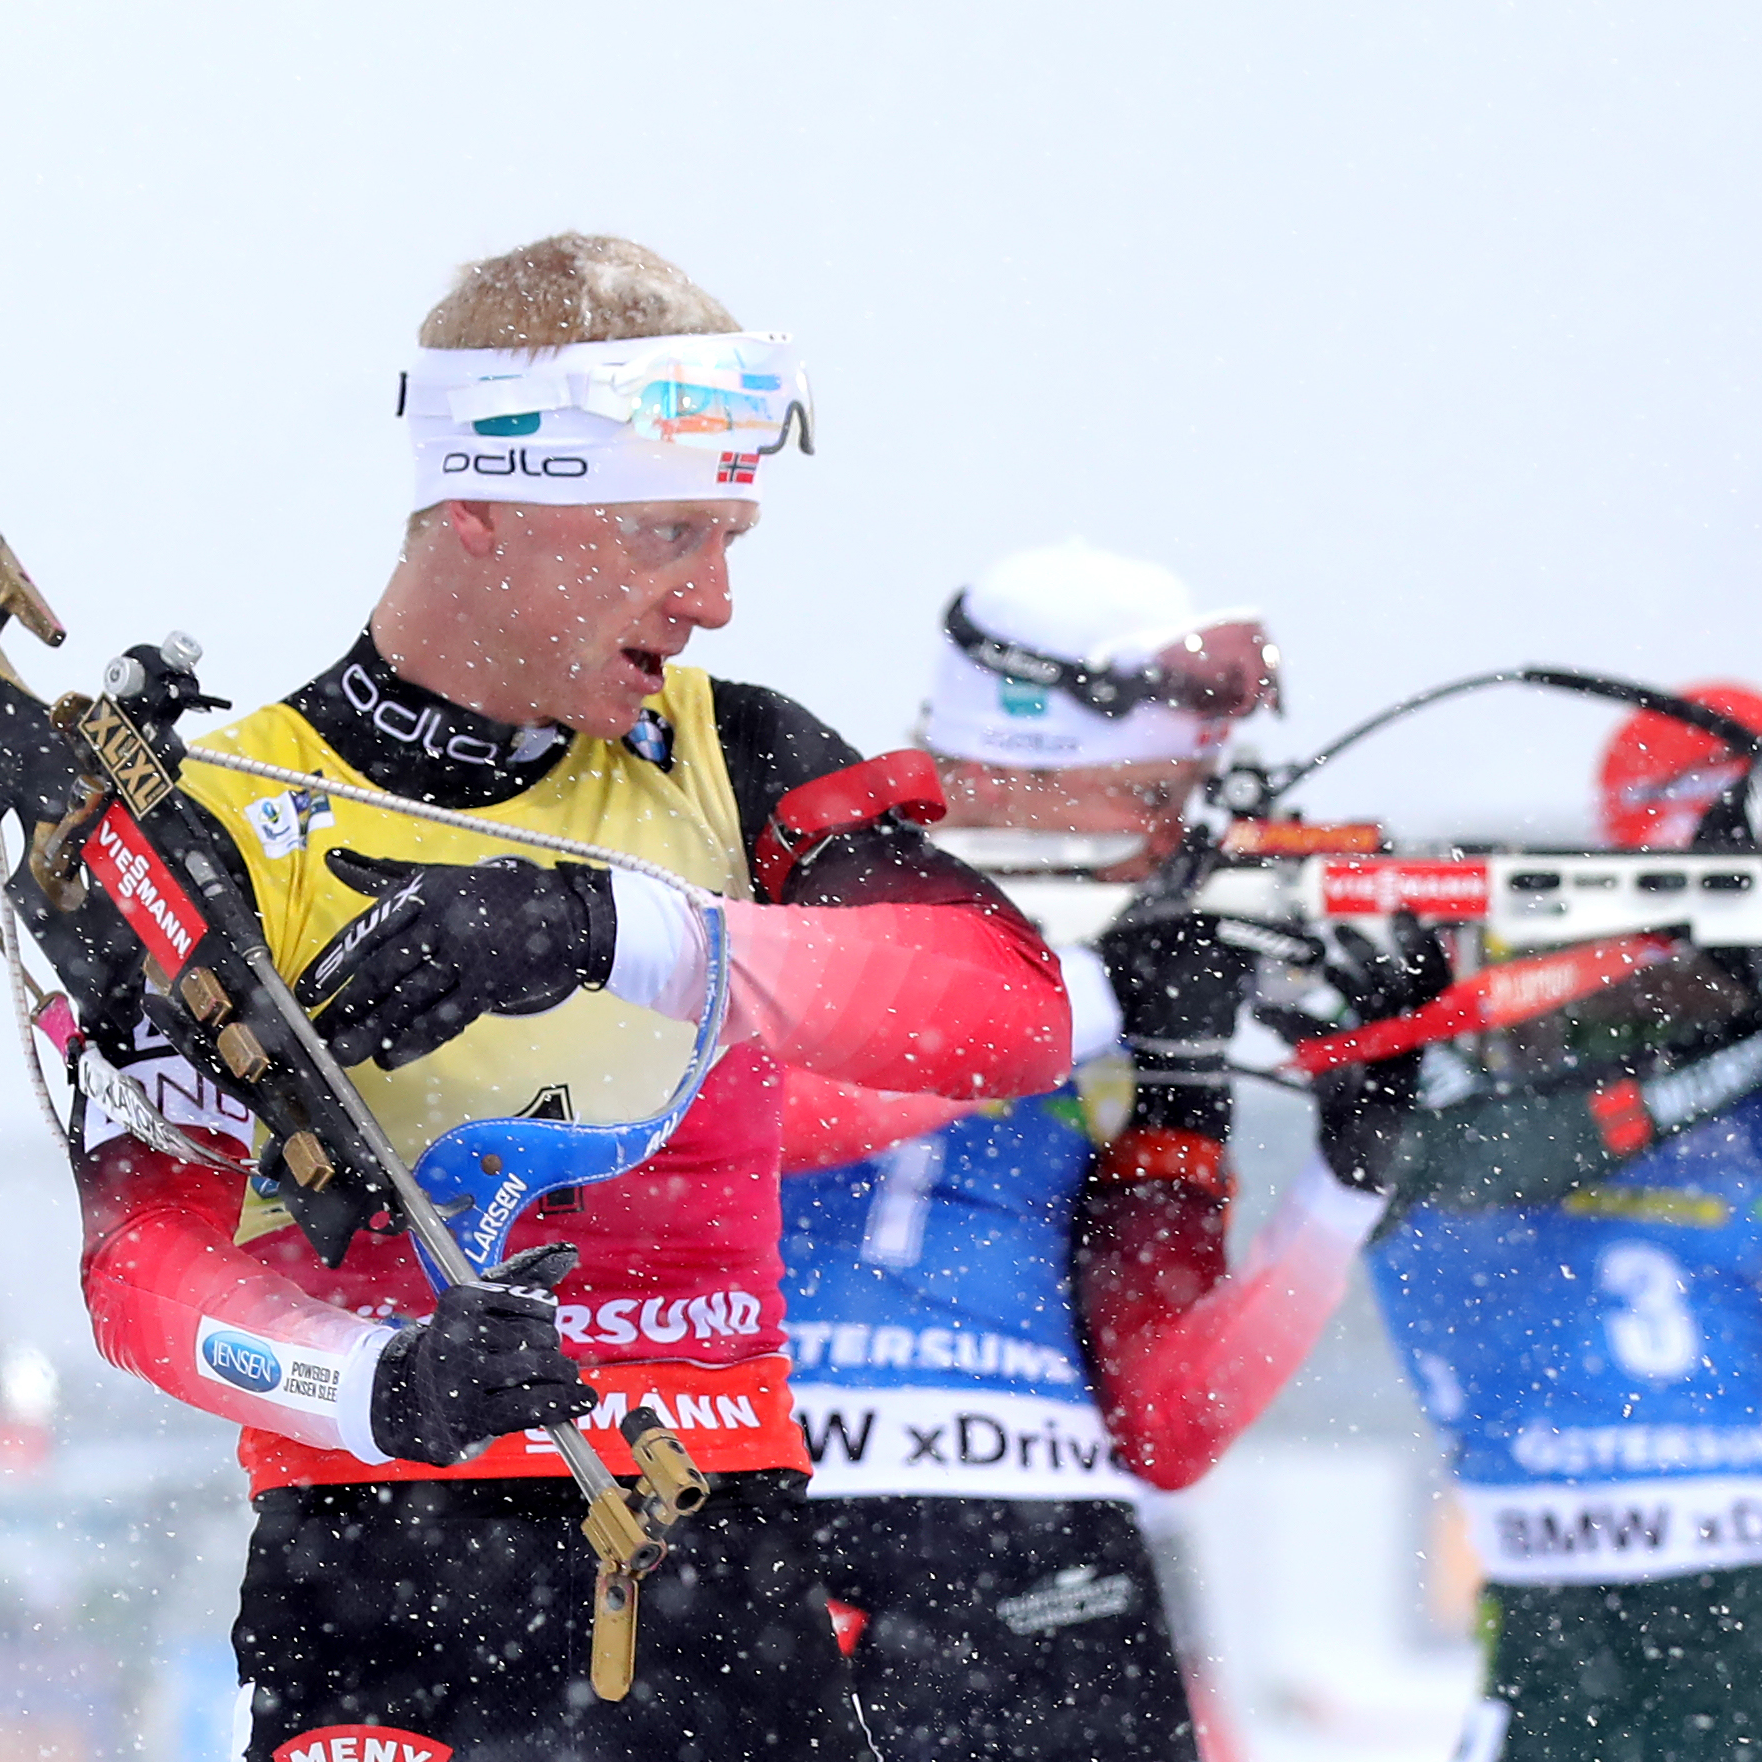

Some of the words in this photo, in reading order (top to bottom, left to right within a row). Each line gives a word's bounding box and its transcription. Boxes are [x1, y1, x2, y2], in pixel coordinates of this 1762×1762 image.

[441, 447, 589, 479] odlo
[340, 662, 499, 765] odlo
[98, 819, 193, 957] VIESSMANN
[464, 1172, 528, 1264] LARSEN
[554, 1290, 763, 1344] RSUND
[1597, 1240, 1701, 1380] 3
[212, 1339, 272, 1383] JENSEN
[283, 1377, 317, 1397] JENSEN
[291, 1360, 331, 1383] POWERED
